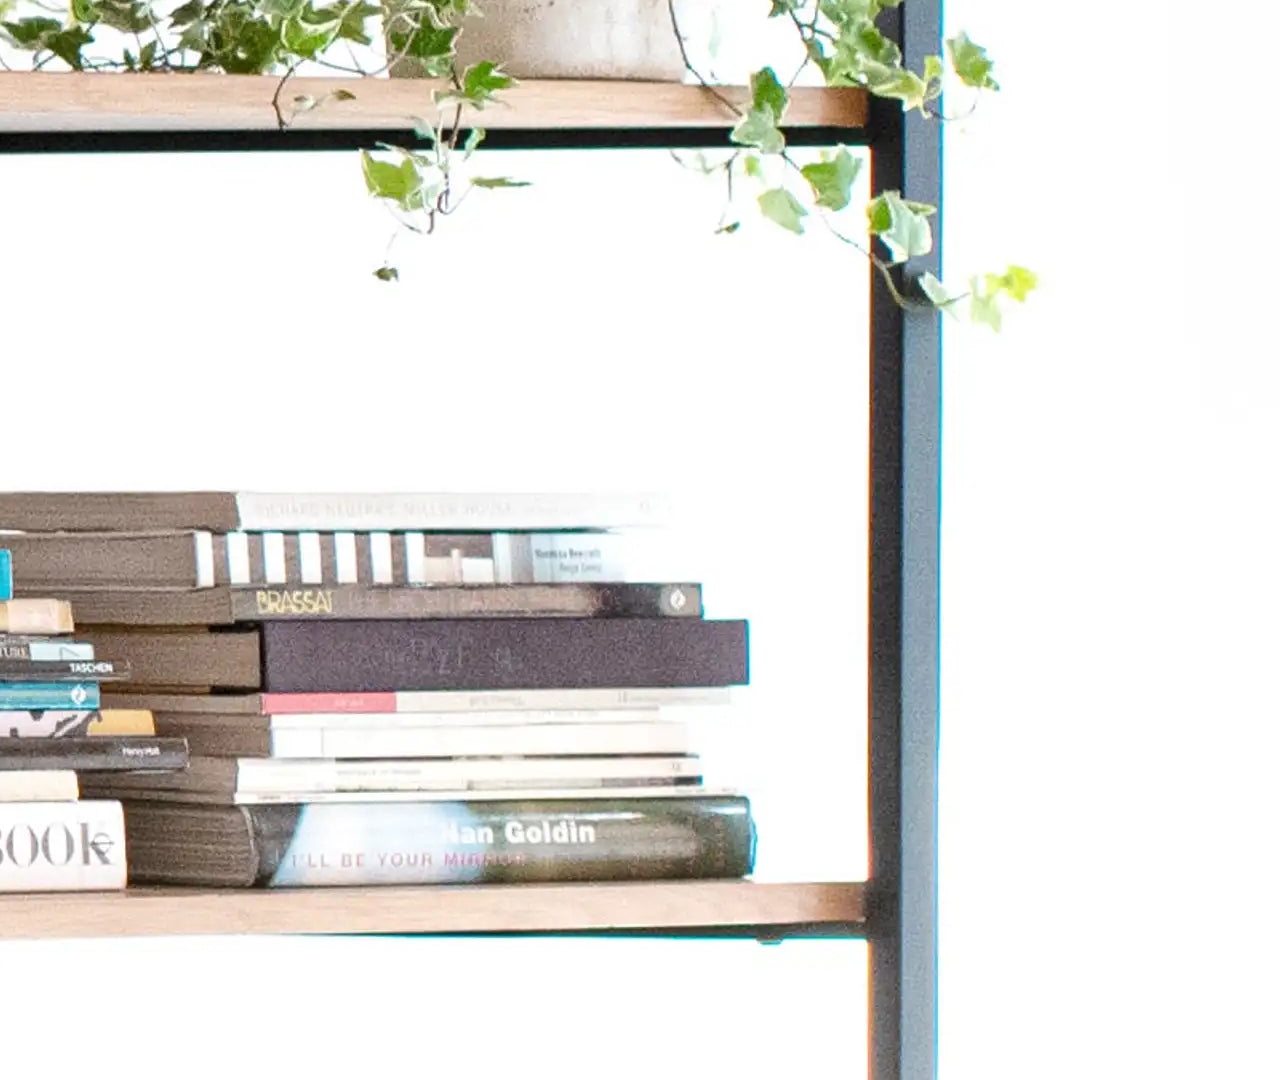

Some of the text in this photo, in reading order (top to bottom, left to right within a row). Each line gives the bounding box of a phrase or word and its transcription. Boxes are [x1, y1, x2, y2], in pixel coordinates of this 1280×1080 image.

[68, 662, 113, 672] TASCHEN
[504, 818, 597, 844] Goldin
[340, 852, 366, 868] BE
[378, 852, 433, 868] YOUR
